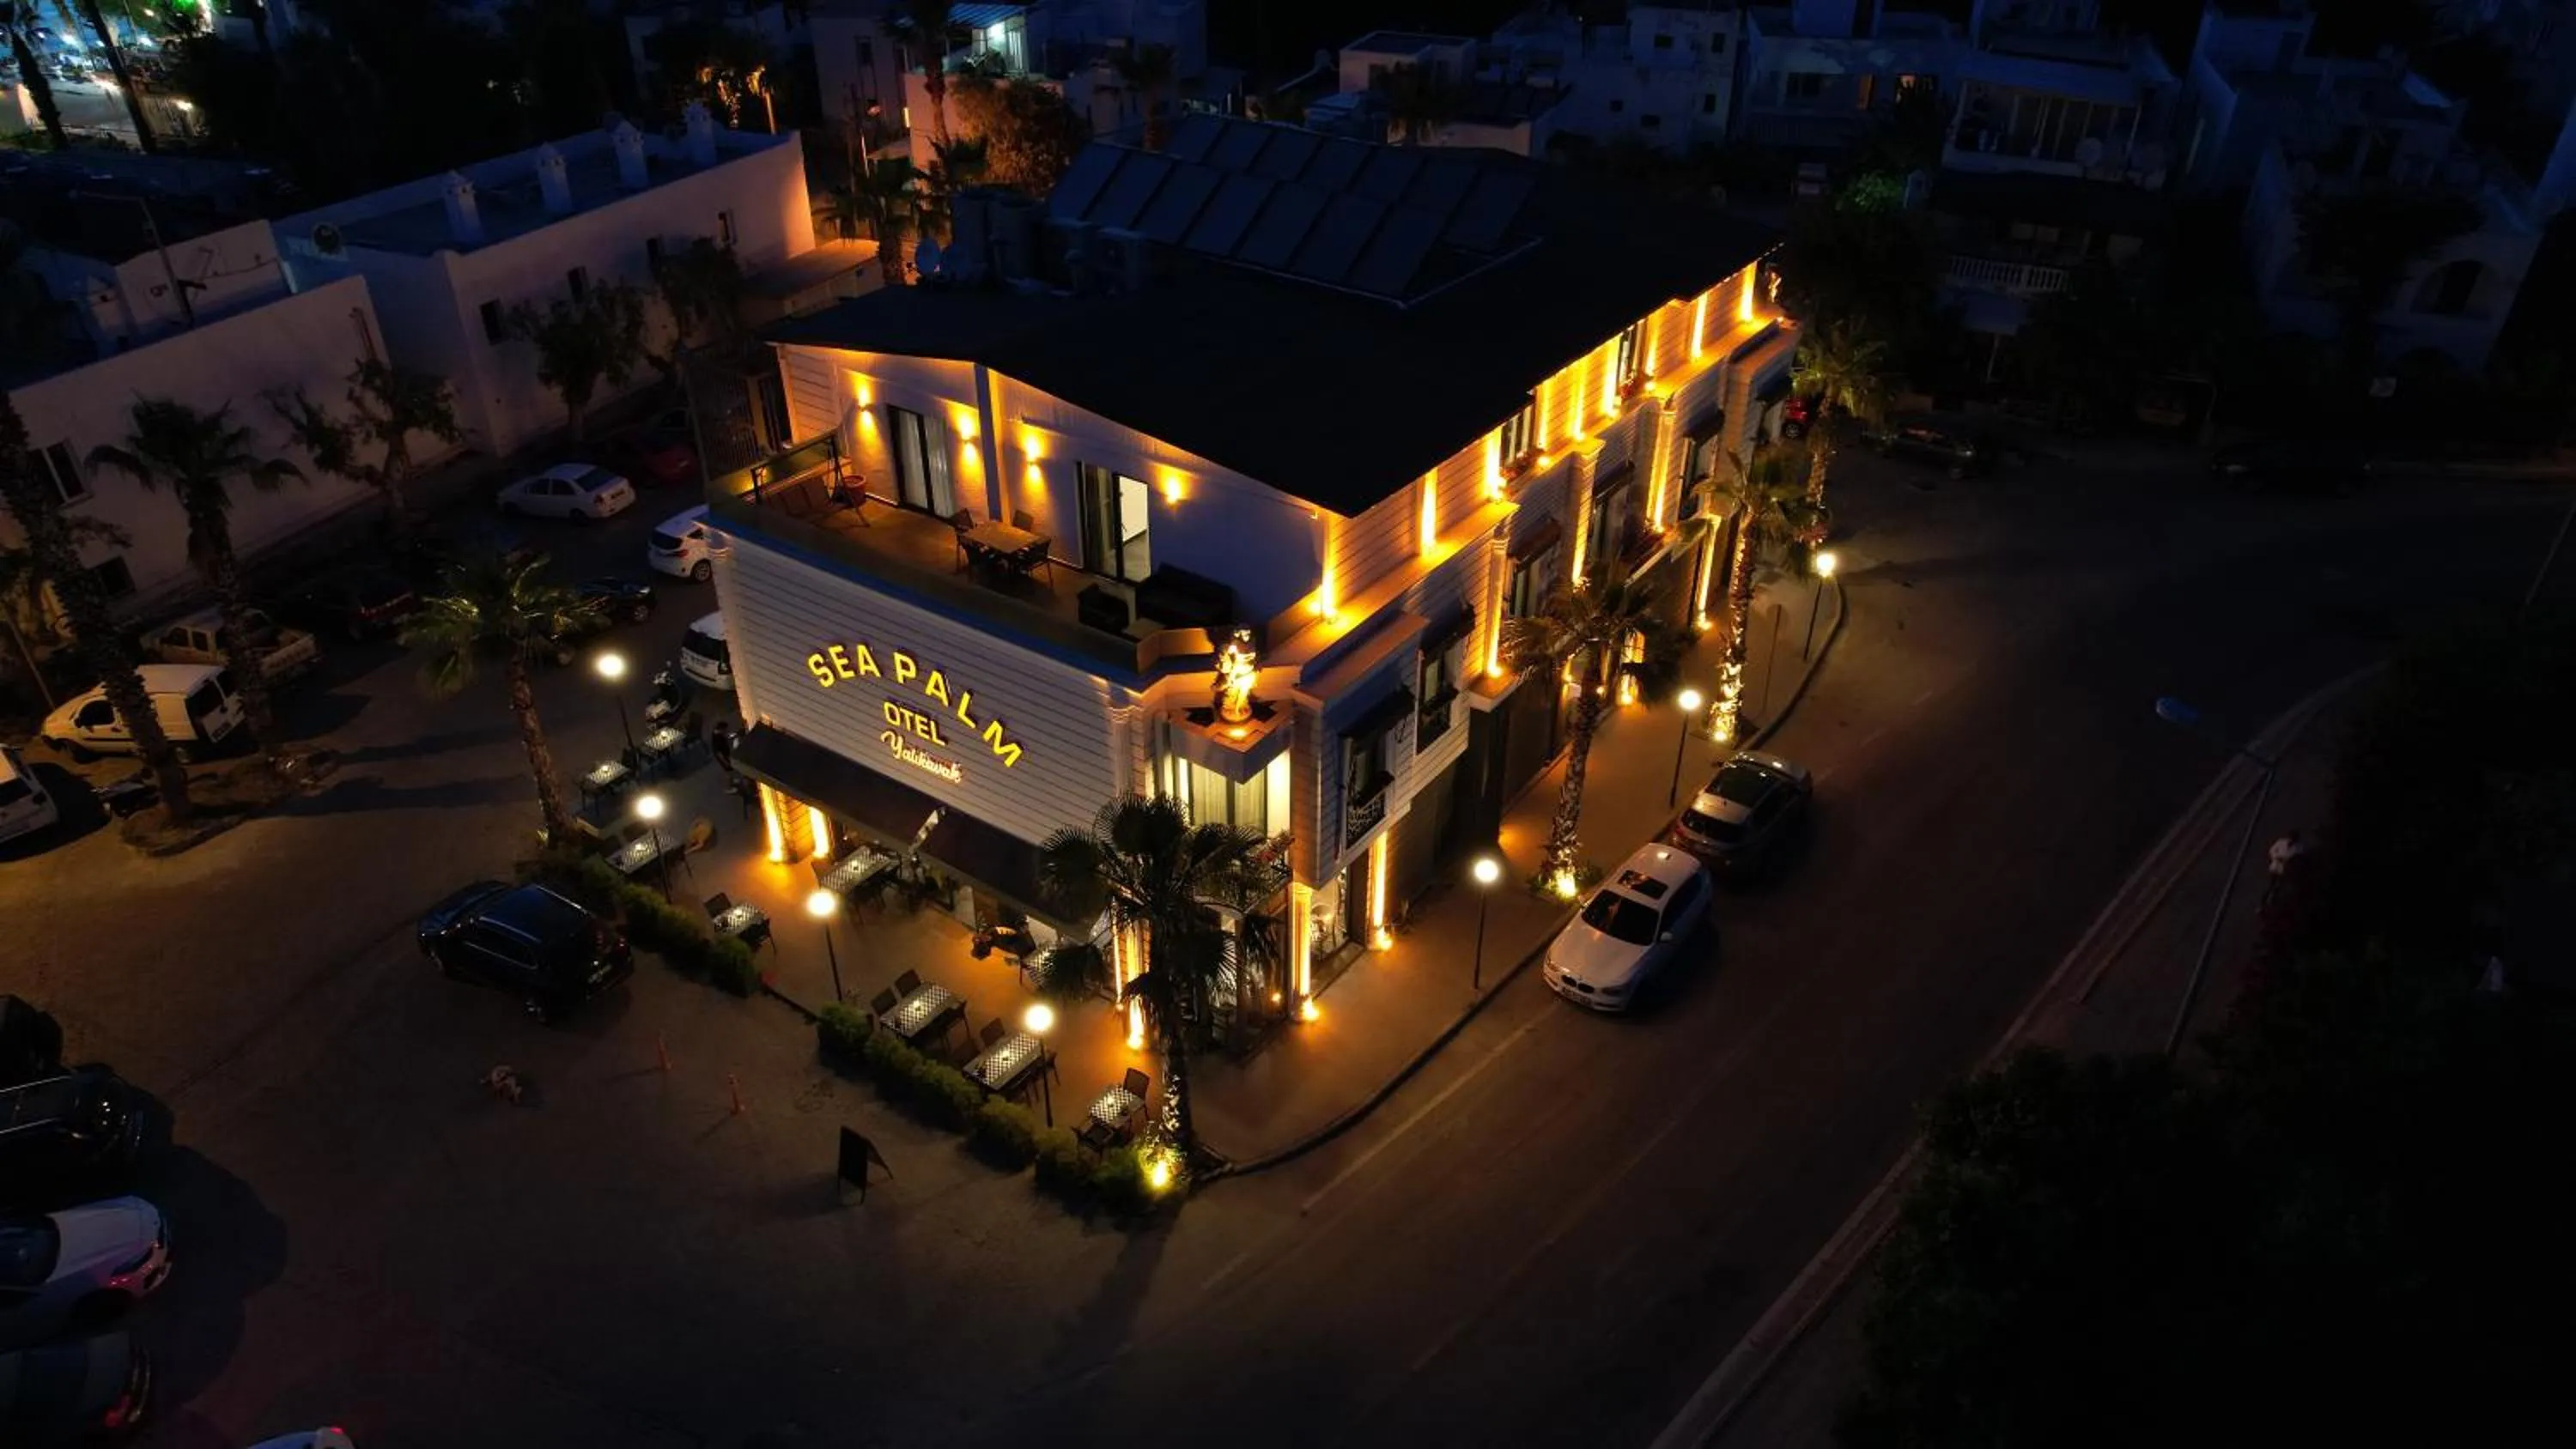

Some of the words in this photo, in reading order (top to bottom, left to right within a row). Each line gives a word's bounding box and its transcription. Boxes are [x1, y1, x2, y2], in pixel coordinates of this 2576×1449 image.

[808, 644, 881, 687] SEA
[893, 652, 1023, 767] PALM
[884, 701, 945, 746] OTEL
